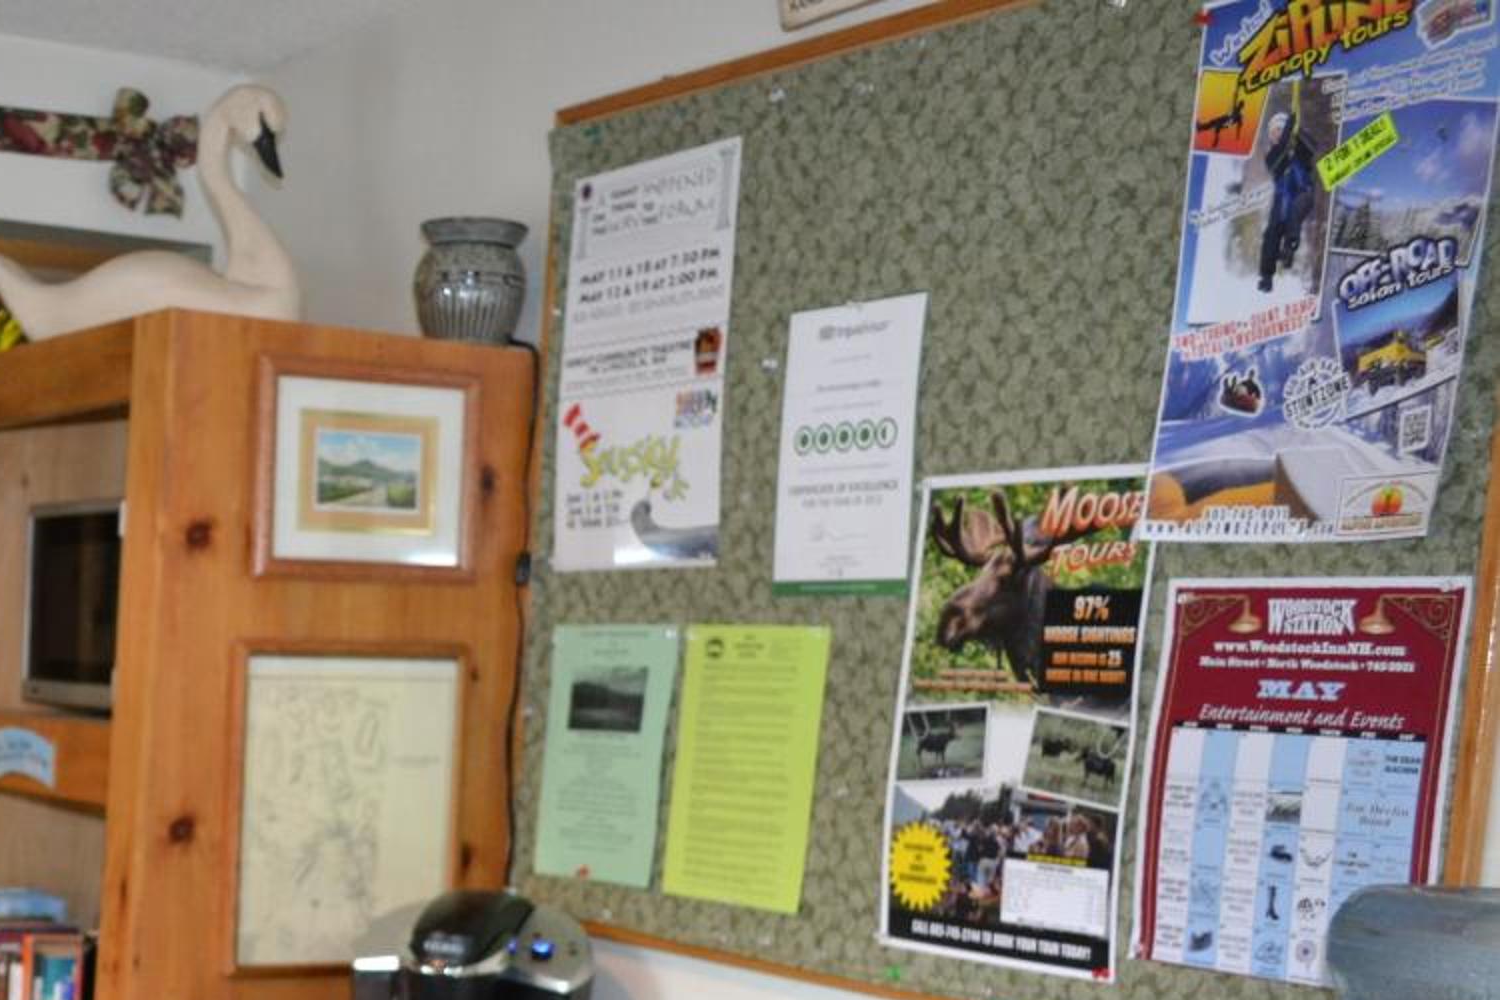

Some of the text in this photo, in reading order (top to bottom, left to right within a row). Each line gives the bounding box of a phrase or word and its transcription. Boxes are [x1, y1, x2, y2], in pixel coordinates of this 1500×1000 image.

[1246, 43, 1332, 91] canopy
[1341, 11, 1409, 49] tours
[580, 271, 605, 285] MAY
[654, 258, 668, 271] AT
[701, 247, 721, 261] PM
[1340, 239, 1457, 299] OFF-ROAD
[1406, 261, 1453, 288] tours
[580, 290, 603, 303] MAY
[651, 276, 666, 291] AT
[699, 267, 718, 281] PM
[1041, 487, 1146, 538] MOOSE
[1049, 541, 1138, 576] TOURS
[1073, 595, 1111, 621] 97%
[1282, 613, 1346, 635] STATION
[1256, 678, 1347, 701] MAY
[1198, 702, 1406, 730] Entertainment and Events
